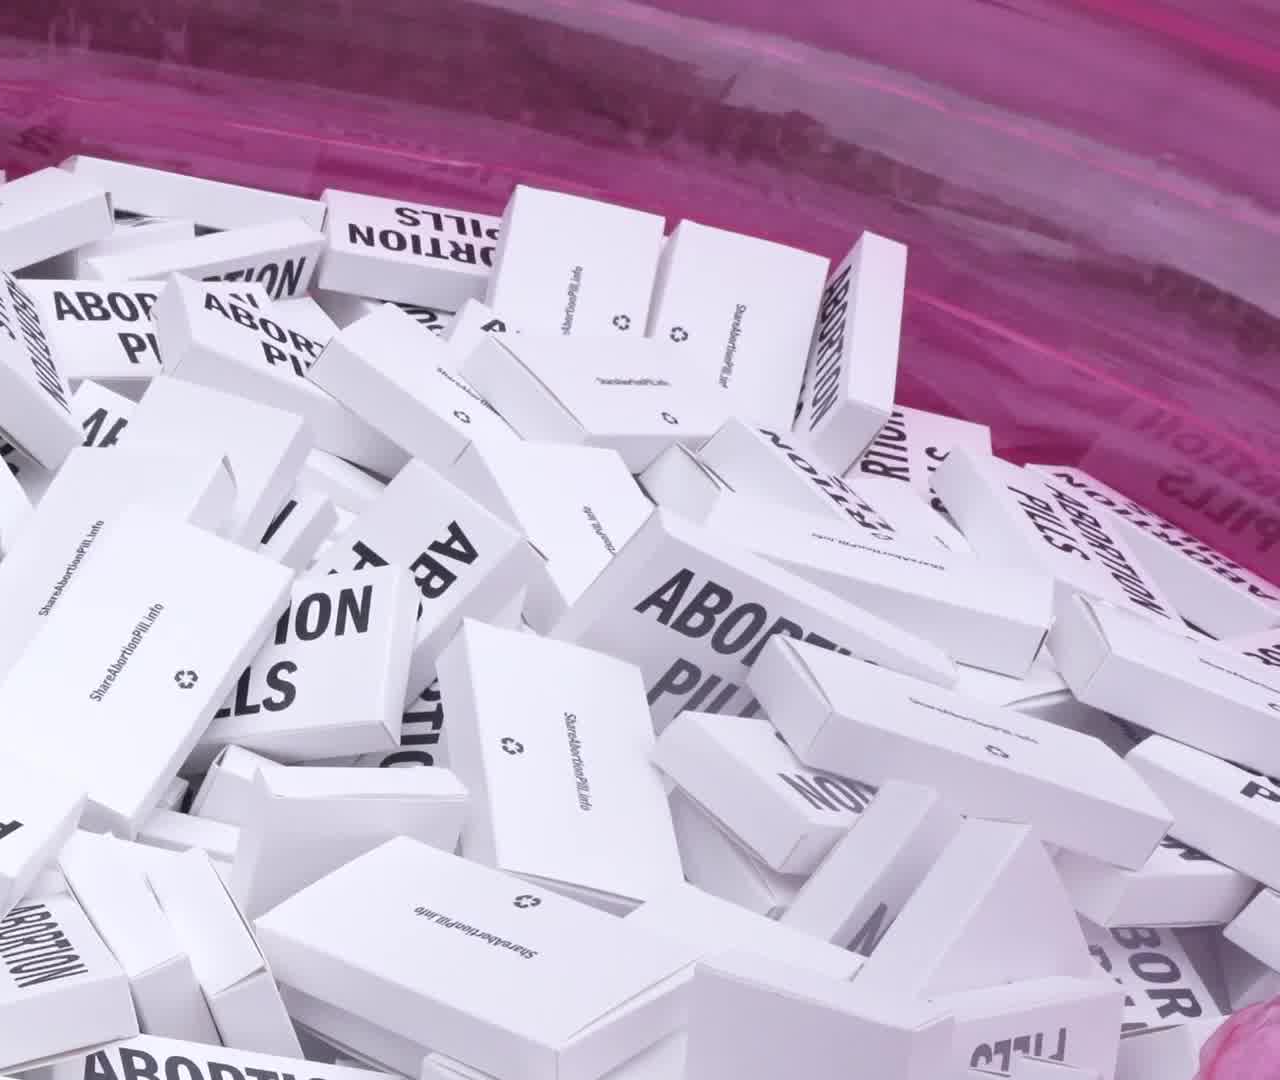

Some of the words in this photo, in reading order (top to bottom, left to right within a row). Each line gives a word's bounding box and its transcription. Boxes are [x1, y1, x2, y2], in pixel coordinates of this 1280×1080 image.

[4, 270, 71, 413] ABORTION
[809, 263, 852, 432] ABORTION
[38, 518, 105, 618] ShareAbortionPill.info
[1007, 485, 1091, 561] PILLS
[1043, 482, 1172, 620] ABORTION
[89, 601, 166, 703] ShareAbortionPill.info
[563, 711, 594, 811] ShareAbortionPill.info
[412, 904, 539, 960] ShareAbortionPill.info
